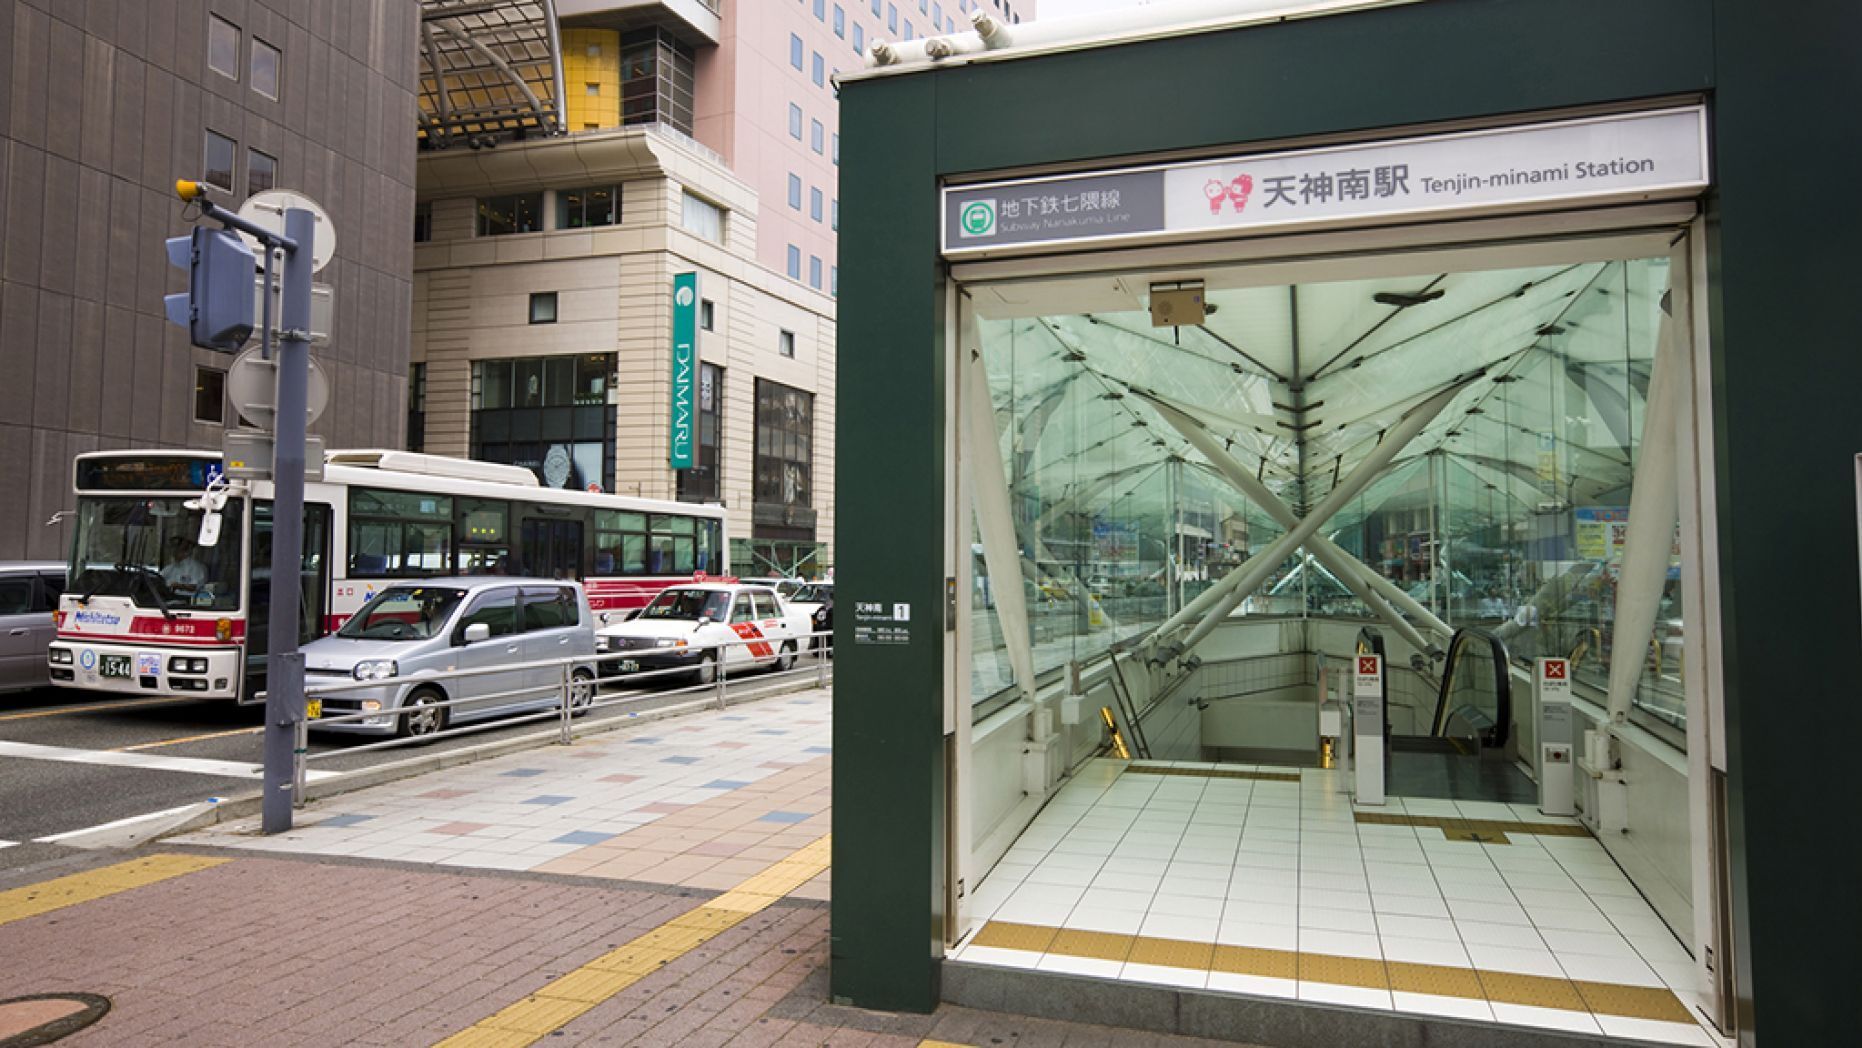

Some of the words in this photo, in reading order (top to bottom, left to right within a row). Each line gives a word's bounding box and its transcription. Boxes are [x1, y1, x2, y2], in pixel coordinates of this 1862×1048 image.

[1263, 164, 1410, 208] 天神南駅
[1421, 163, 1569, 195] Tenjin-minami
[1575, 157, 1656, 179] Station
[1000, 221, 1040, 232] Subway
[1044, 215, 1104, 229] Nanakuma
[1107, 212, 1131, 223] Line
[1001, 188, 1120, 218] 地下鉄七隈線
[675, 343, 690, 460] DAIMARU
